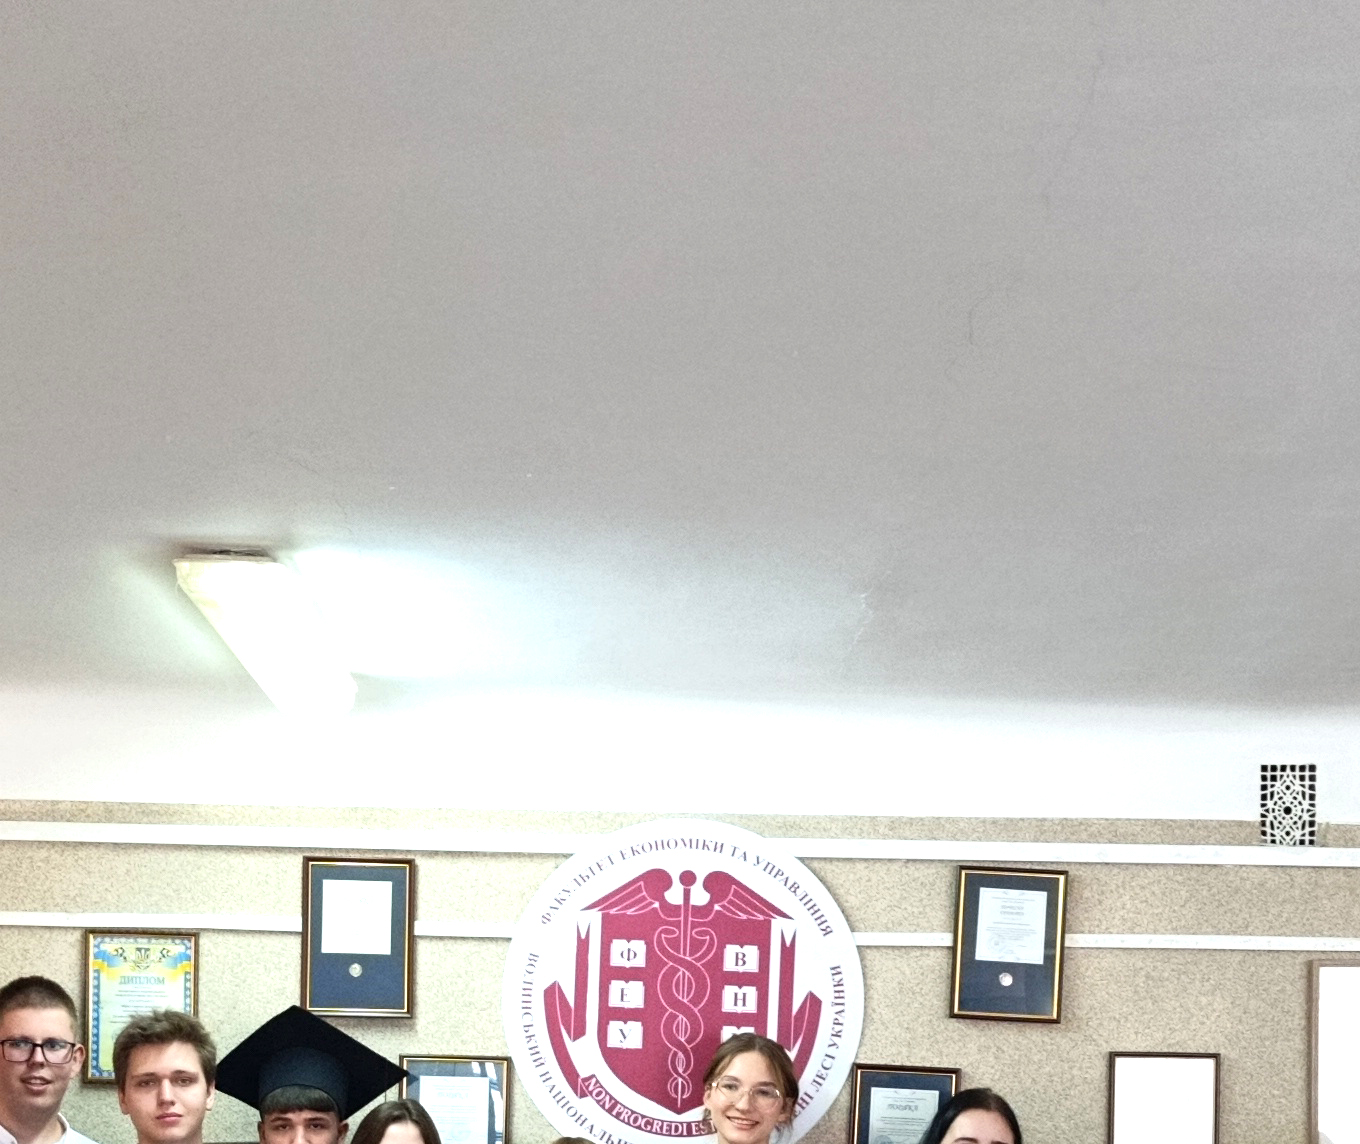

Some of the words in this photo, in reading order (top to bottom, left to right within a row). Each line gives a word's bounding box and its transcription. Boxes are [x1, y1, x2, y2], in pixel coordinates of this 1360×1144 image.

[541, 853, 615, 925] ФАКУЛЬТЕТ
[620, 837, 724, 861] ЕКОНОМІКИ
[730, 845, 749, 862] ТА
[753, 855, 834, 937] УПРАВЛІННЯ
[620, 947, 637, 962] Ф
[735, 952, 747, 967] В
[119, 976, 165, 985] ДИПЛОМ
[620, 989, 630, 1003] Е
[733, 993, 747, 1007] Н
[521, 952, 549, 1068] ВОЛИНСЬКИЙ
[811, 1053, 837, 1093] ЛЕСІ
[827, 964, 845, 1051] УКРАЇНКИ
[617, 1028, 633, 1044] У
[585, 1076, 612, 1109] NON
[612, 1103, 688, 1136] PROGREDI
